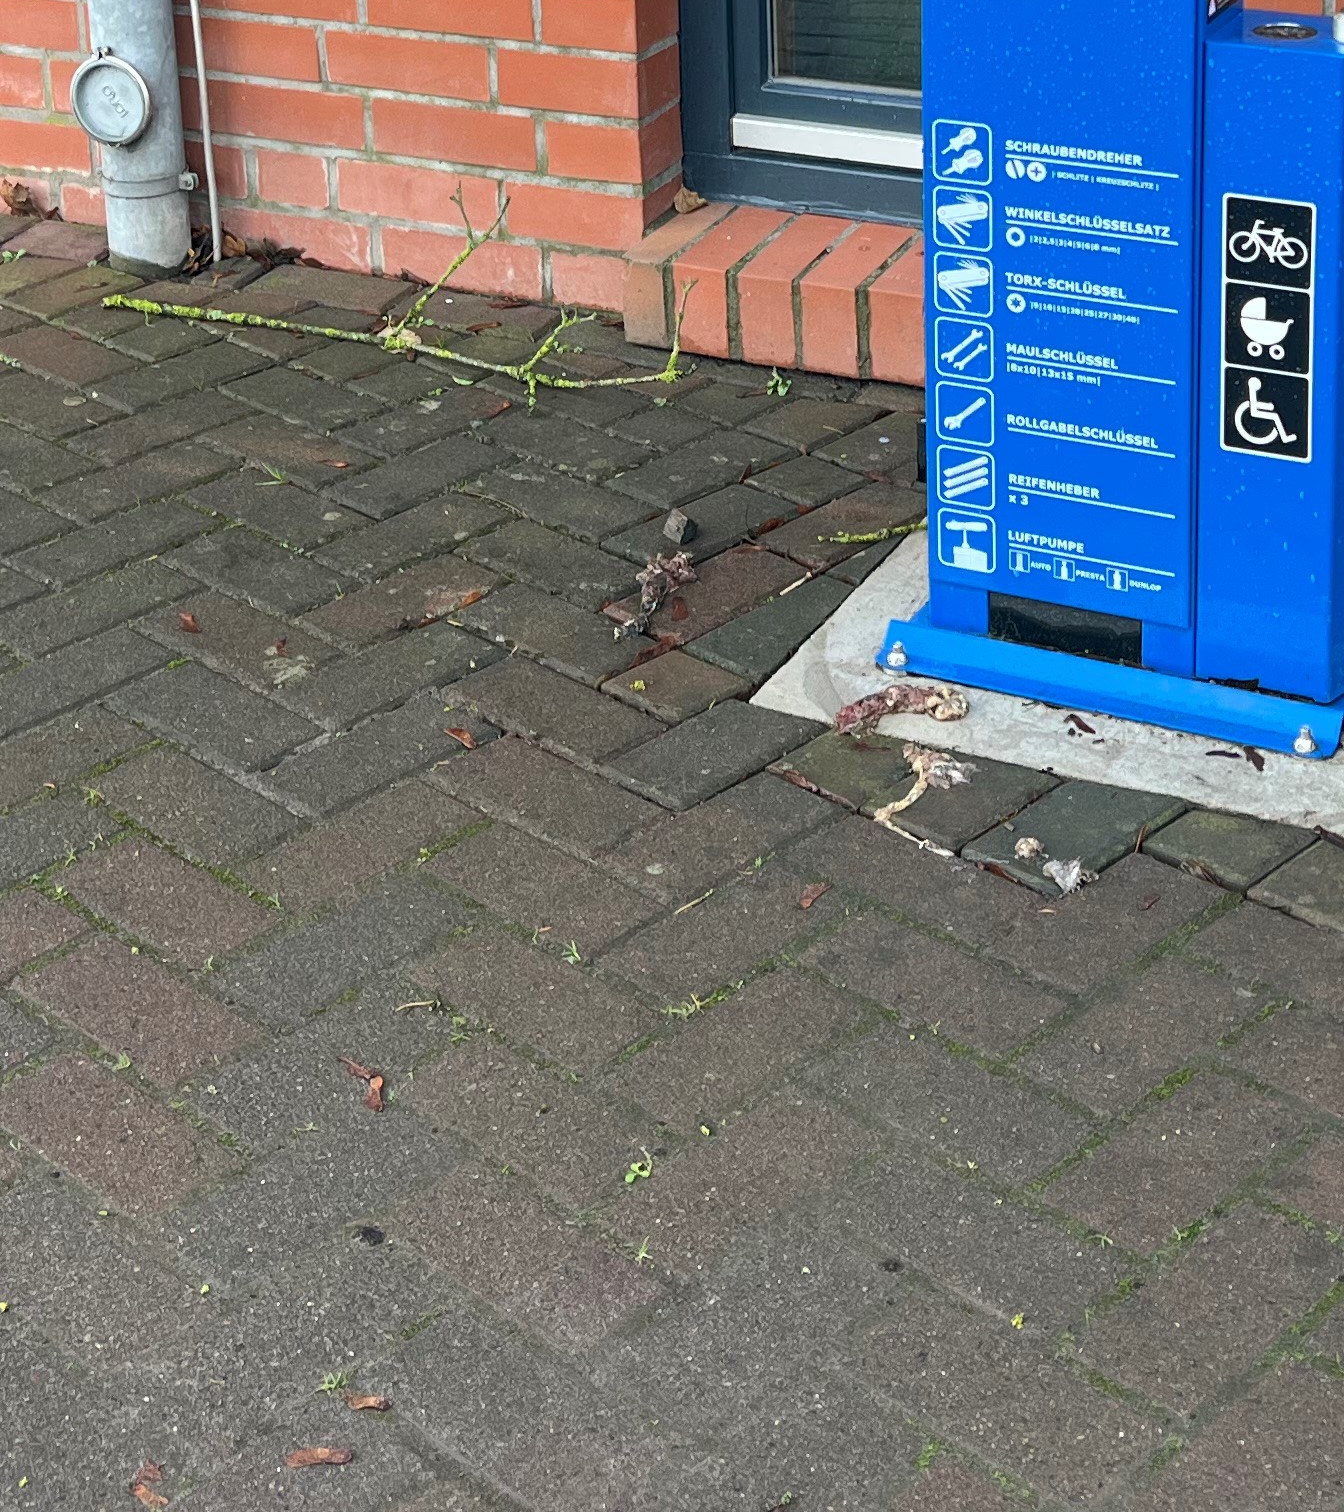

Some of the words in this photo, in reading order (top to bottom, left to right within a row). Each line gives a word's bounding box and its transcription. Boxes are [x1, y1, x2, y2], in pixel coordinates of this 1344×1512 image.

[1005, 139, 1143, 167] SCHRAUBENDREHER
[1005, 206, 1171, 238] WINKELSCHLÜSSELSATZ
[1005, 272, 1127, 300] TORX-SCHLÜSSEL
[1006, 343, 1119, 370] MAULSCHLÜSSEL
[1006, 414, 1159, 449] ROLLGABELSCHLÜSSEL
[1008, 473, 1100, 499] REIFENHEBER
[1020, 493, 1029, 506] 3
[1008, 530, 1085, 554] LUFTPUMPE
[1030, 561, 1052, 572] AUTO
[1075, 569, 1106, 582] PRESTA
[1129, 580, 1162, 593] DUNLOP
